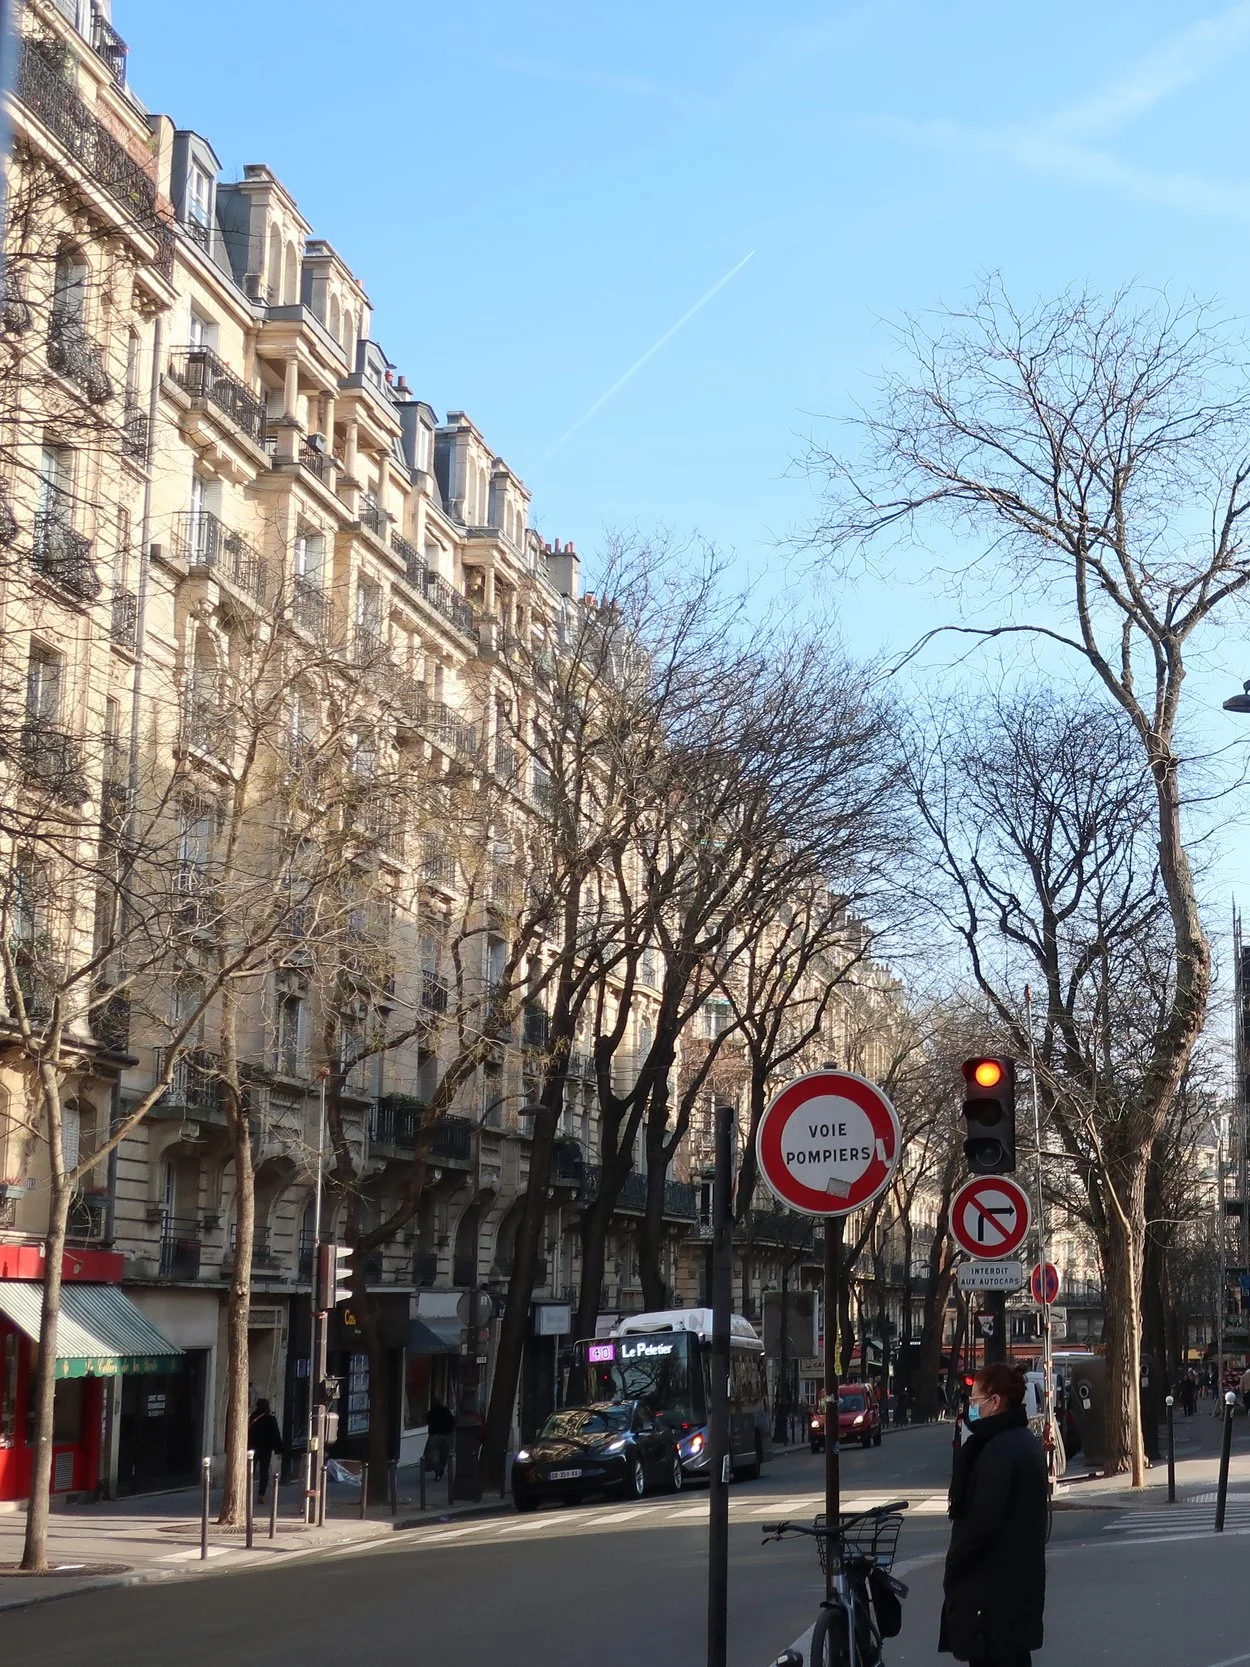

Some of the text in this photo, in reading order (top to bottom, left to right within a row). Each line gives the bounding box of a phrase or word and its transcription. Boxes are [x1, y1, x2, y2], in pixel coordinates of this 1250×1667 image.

[808, 1122, 848, 1139] VOIE
[786, 1147, 872, 1165] POMPIERS
[971, 1267, 1009, 1275] INTERDIT
[960, 1278, 976, 1286] AUX
[592, 1342, 674, 1359] 40 Le Peletier
